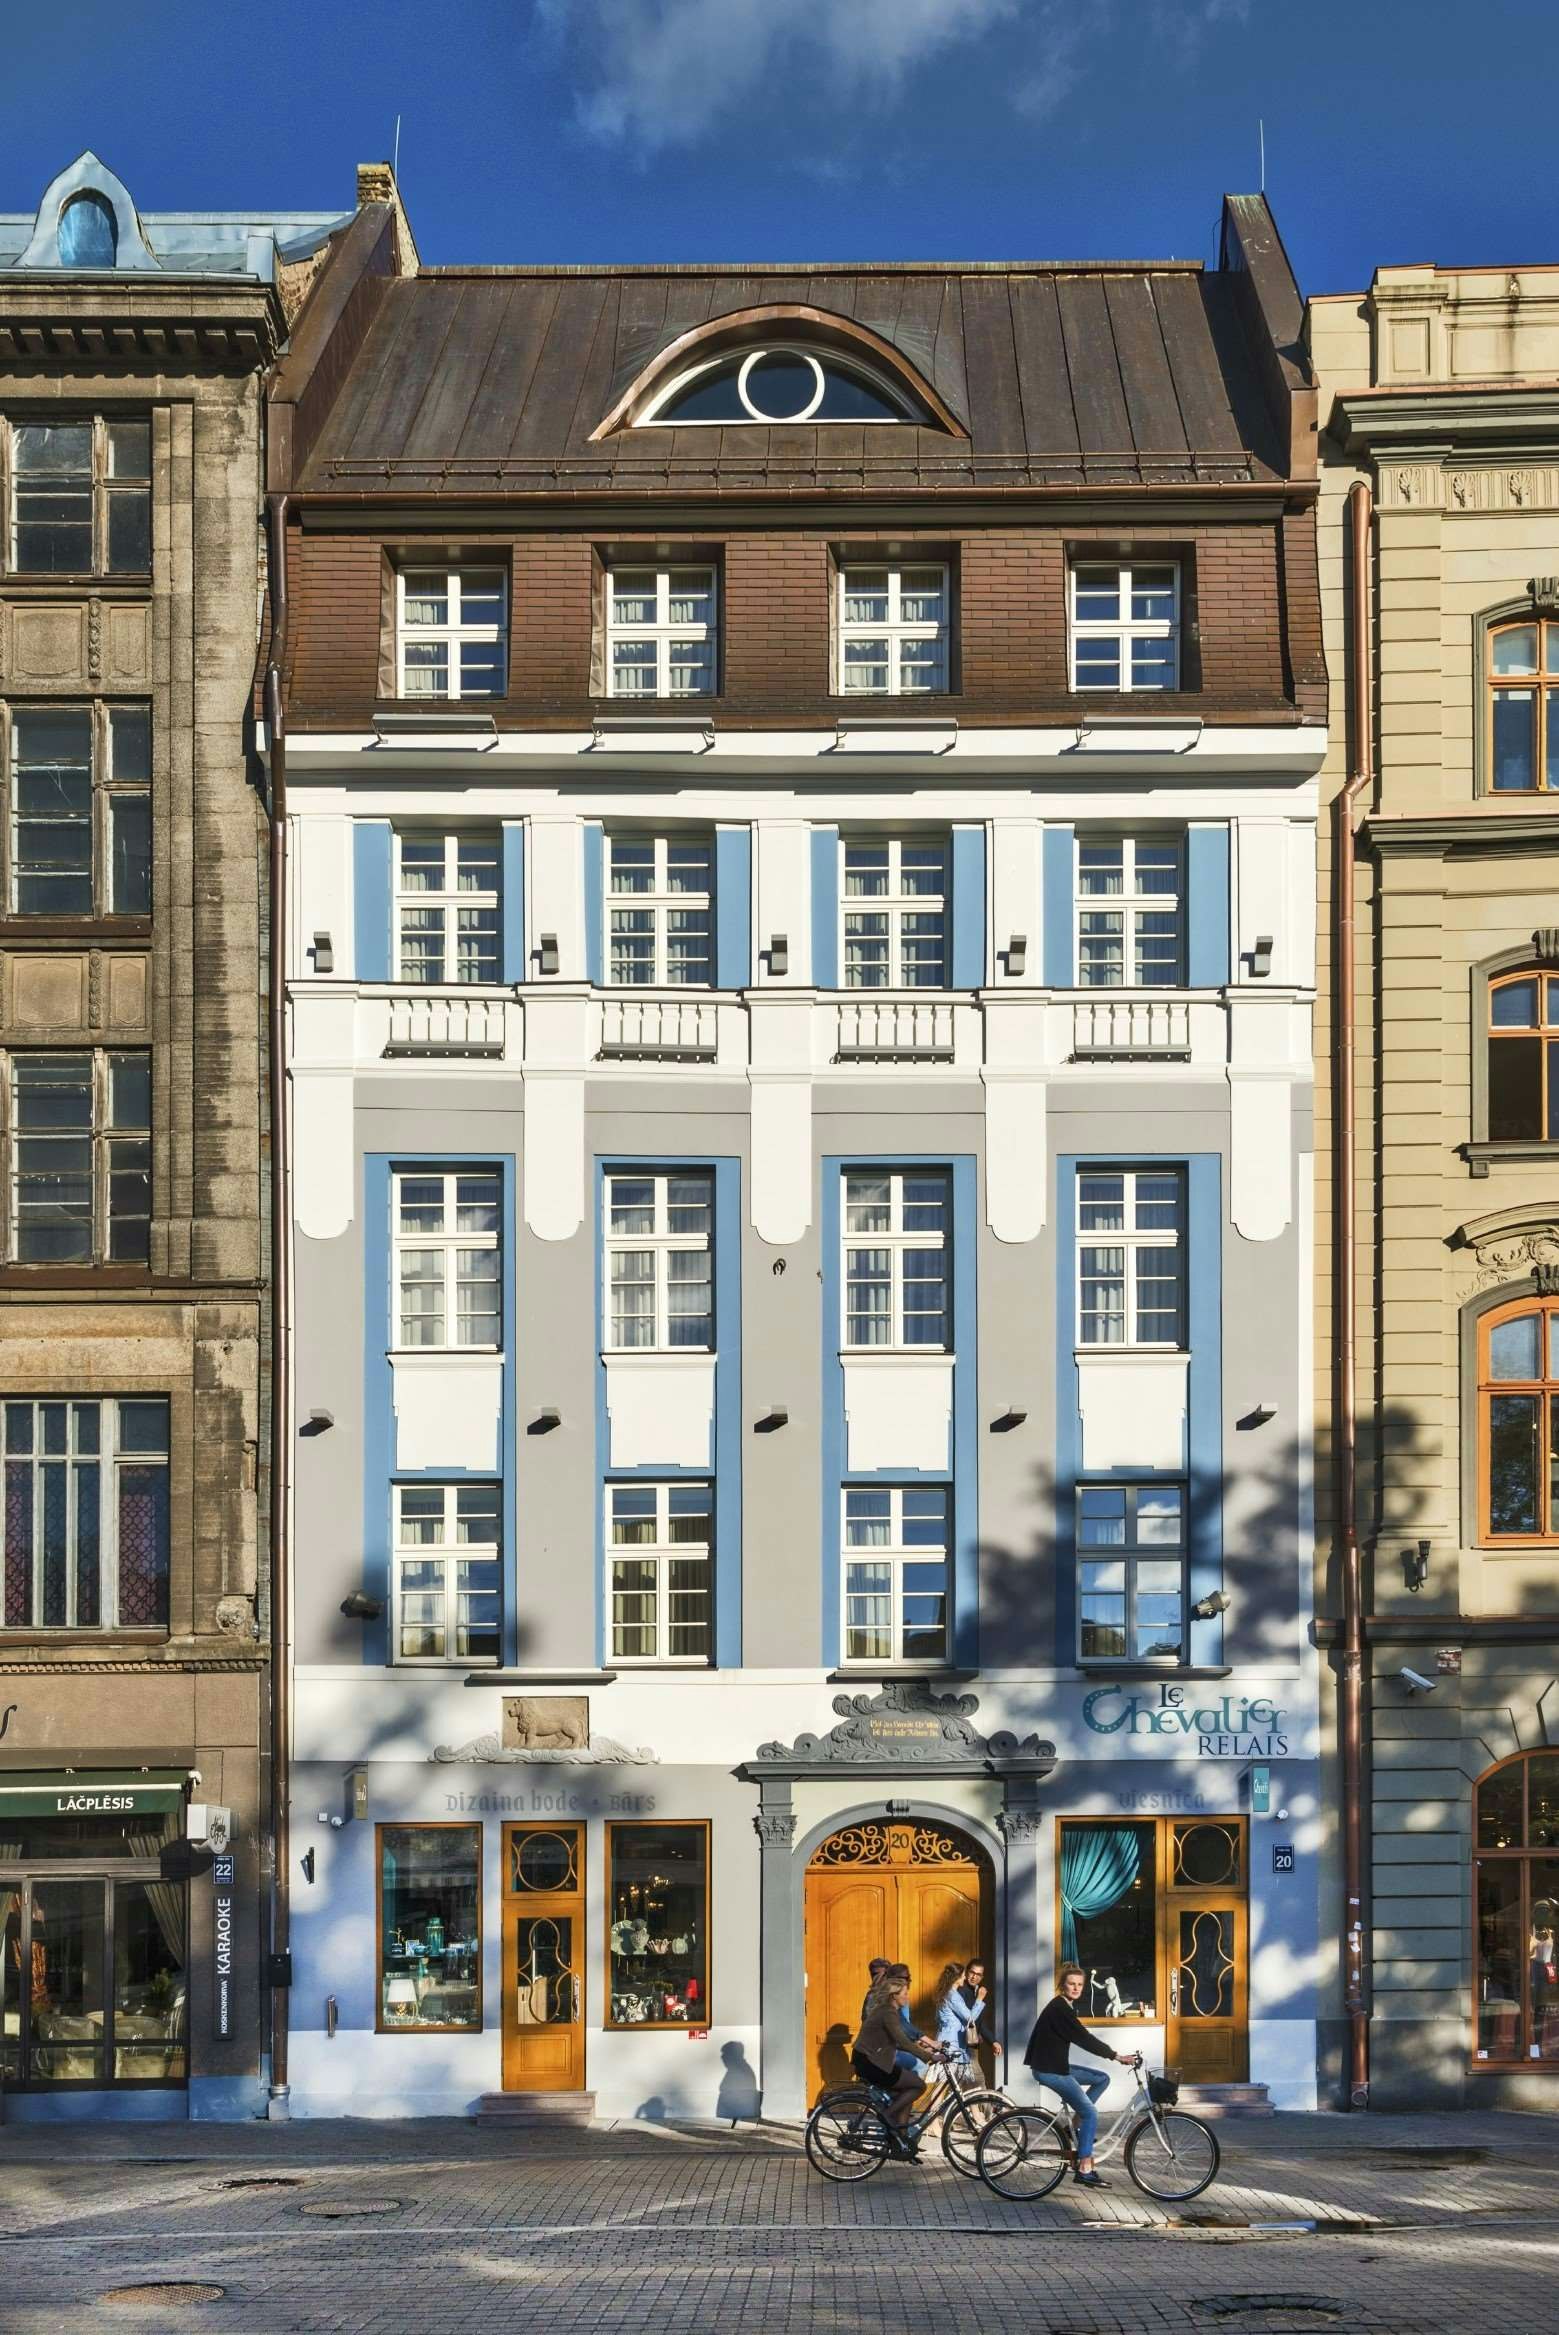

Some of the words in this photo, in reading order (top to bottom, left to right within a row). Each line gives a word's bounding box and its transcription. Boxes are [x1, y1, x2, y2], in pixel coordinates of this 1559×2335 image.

[1198, 1735, 1289, 1756] RELAIS
[57, 1794, 135, 1811] LĀČPLĒSIS
[445, 1792, 525, 1811] Dizaina
[531, 1789, 577, 1811] bode
[891, 1832, 910, 1849] 20
[215, 1863, 232, 1876] 22
[1276, 1855, 1292, 1868] 20
[217, 1897, 231, 1975] KARAOKE
